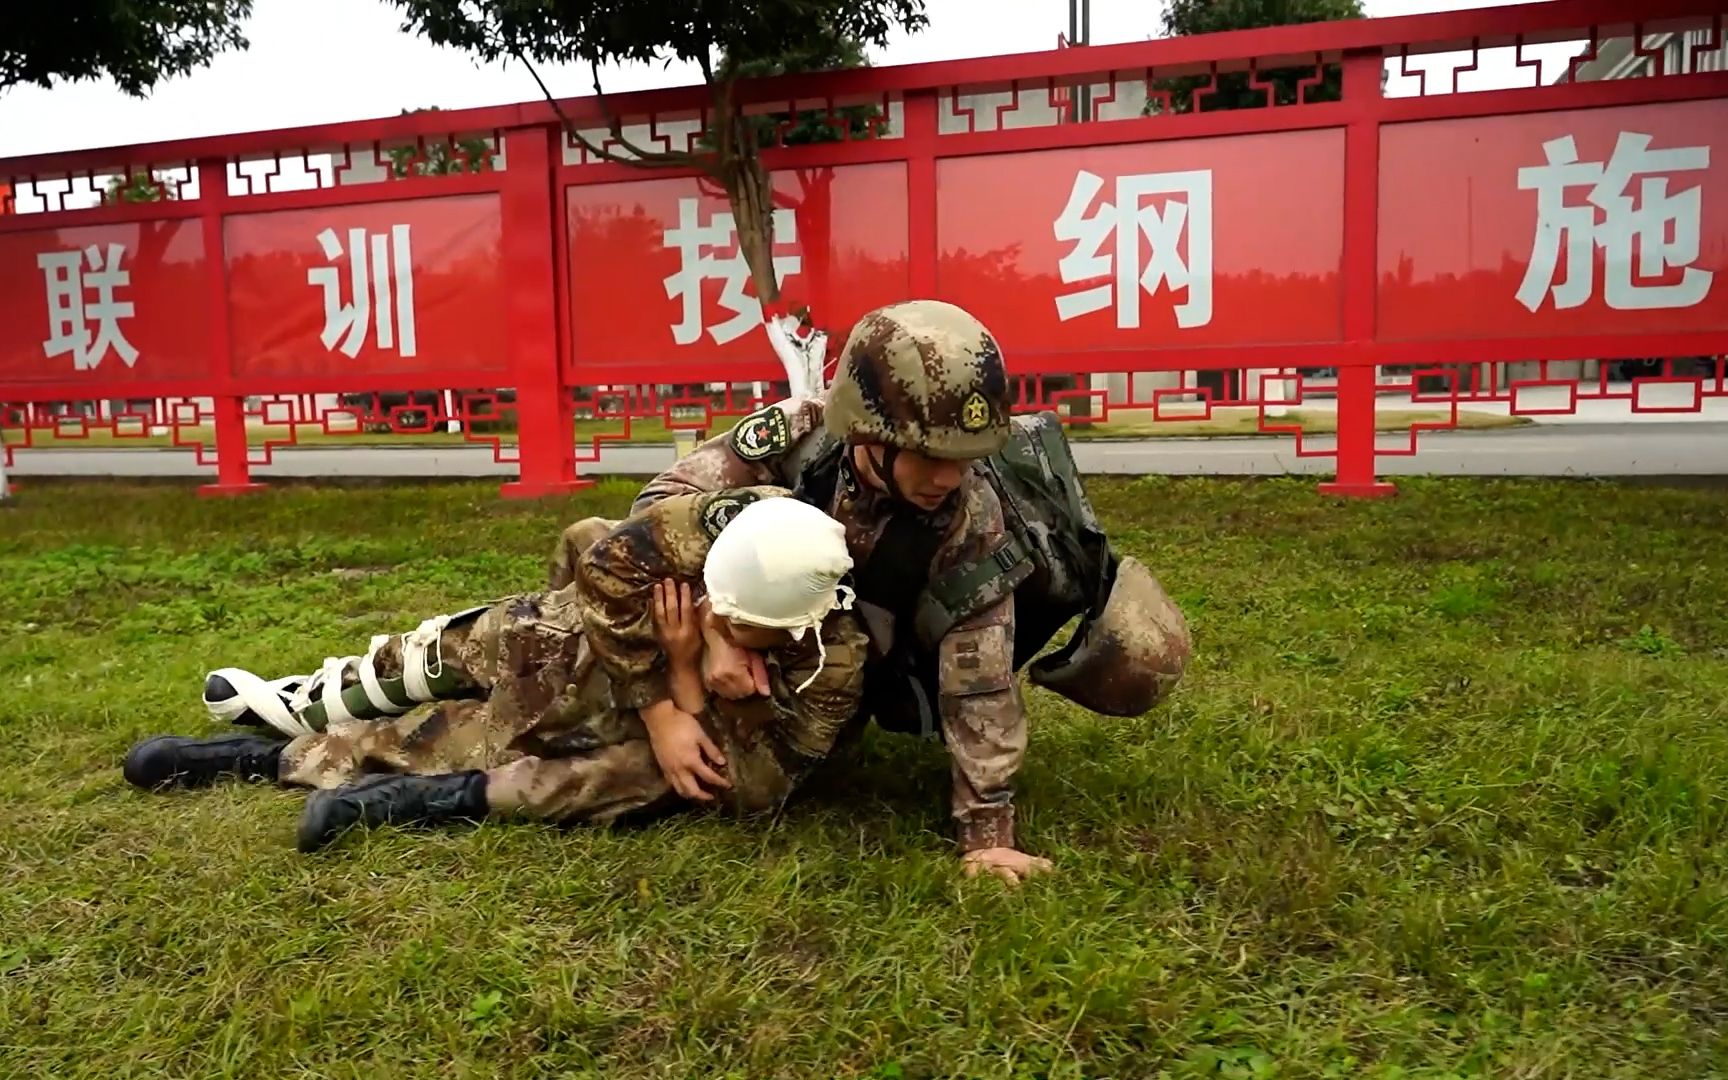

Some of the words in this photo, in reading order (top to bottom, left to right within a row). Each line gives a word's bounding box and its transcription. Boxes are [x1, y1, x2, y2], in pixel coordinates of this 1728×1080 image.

[37, 243, 140, 370] 联
[307, 223, 416, 358] 训
[663, 198, 802, 345] 按
[1053, 168, 1213, 329] 纲
[1514, 131, 1713, 313] 施
